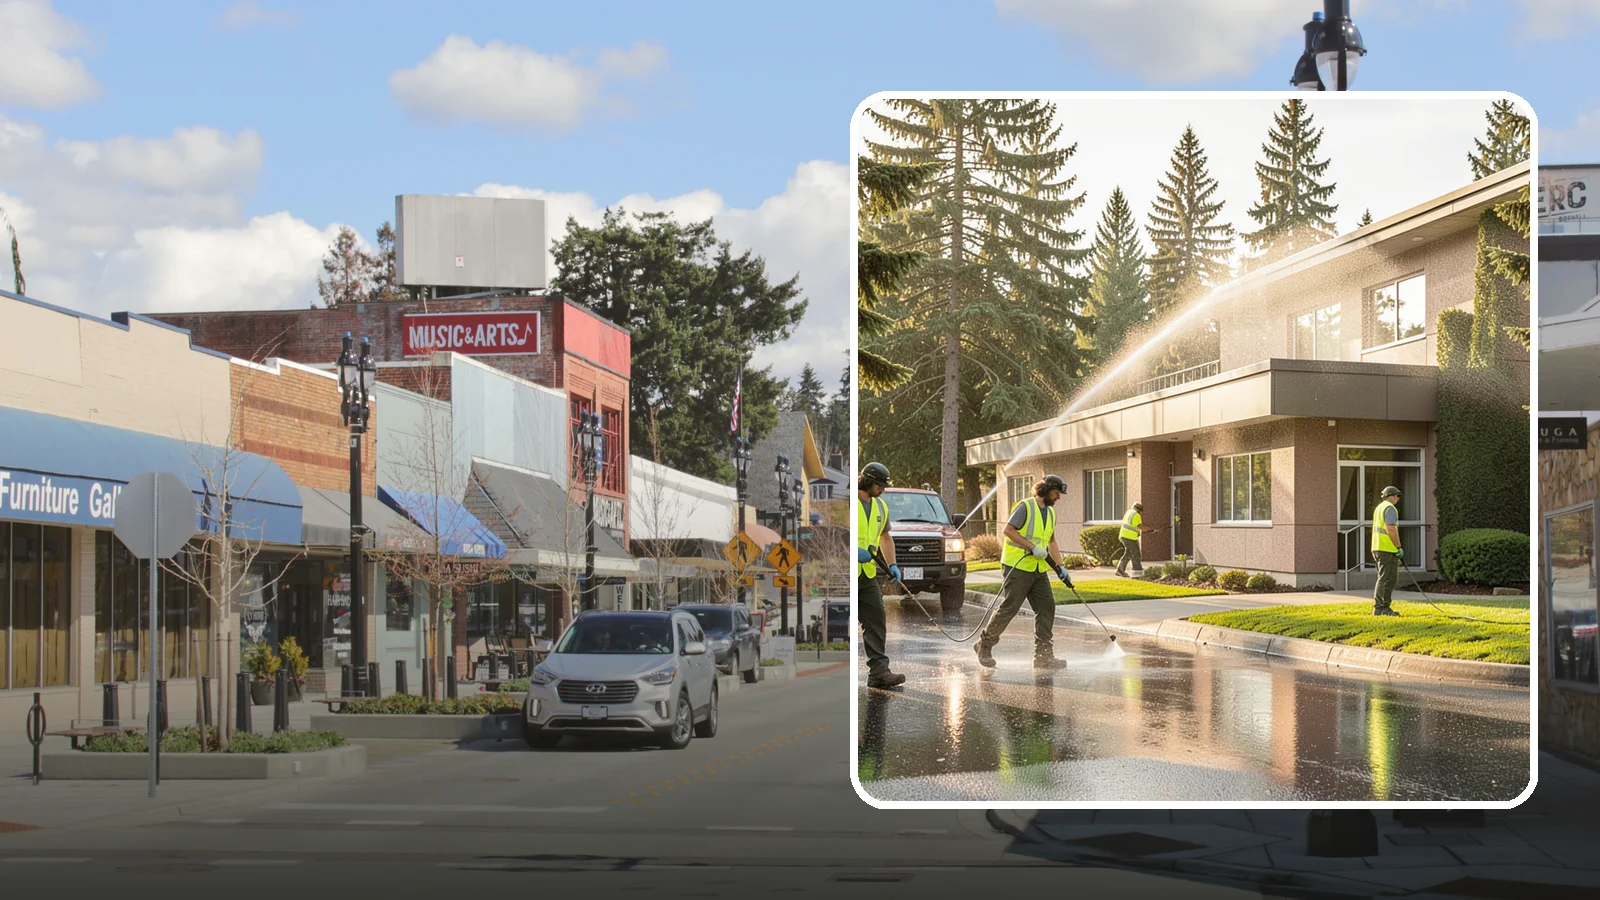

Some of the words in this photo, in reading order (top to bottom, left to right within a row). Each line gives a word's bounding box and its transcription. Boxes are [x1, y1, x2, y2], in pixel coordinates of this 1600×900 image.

[409, 323, 519, 349] MUSIC&ARTS
[0, 471, 79, 515] Furniture
[89, 483, 121, 519] Gal
[453, 563, 479, 574] SUSHI
